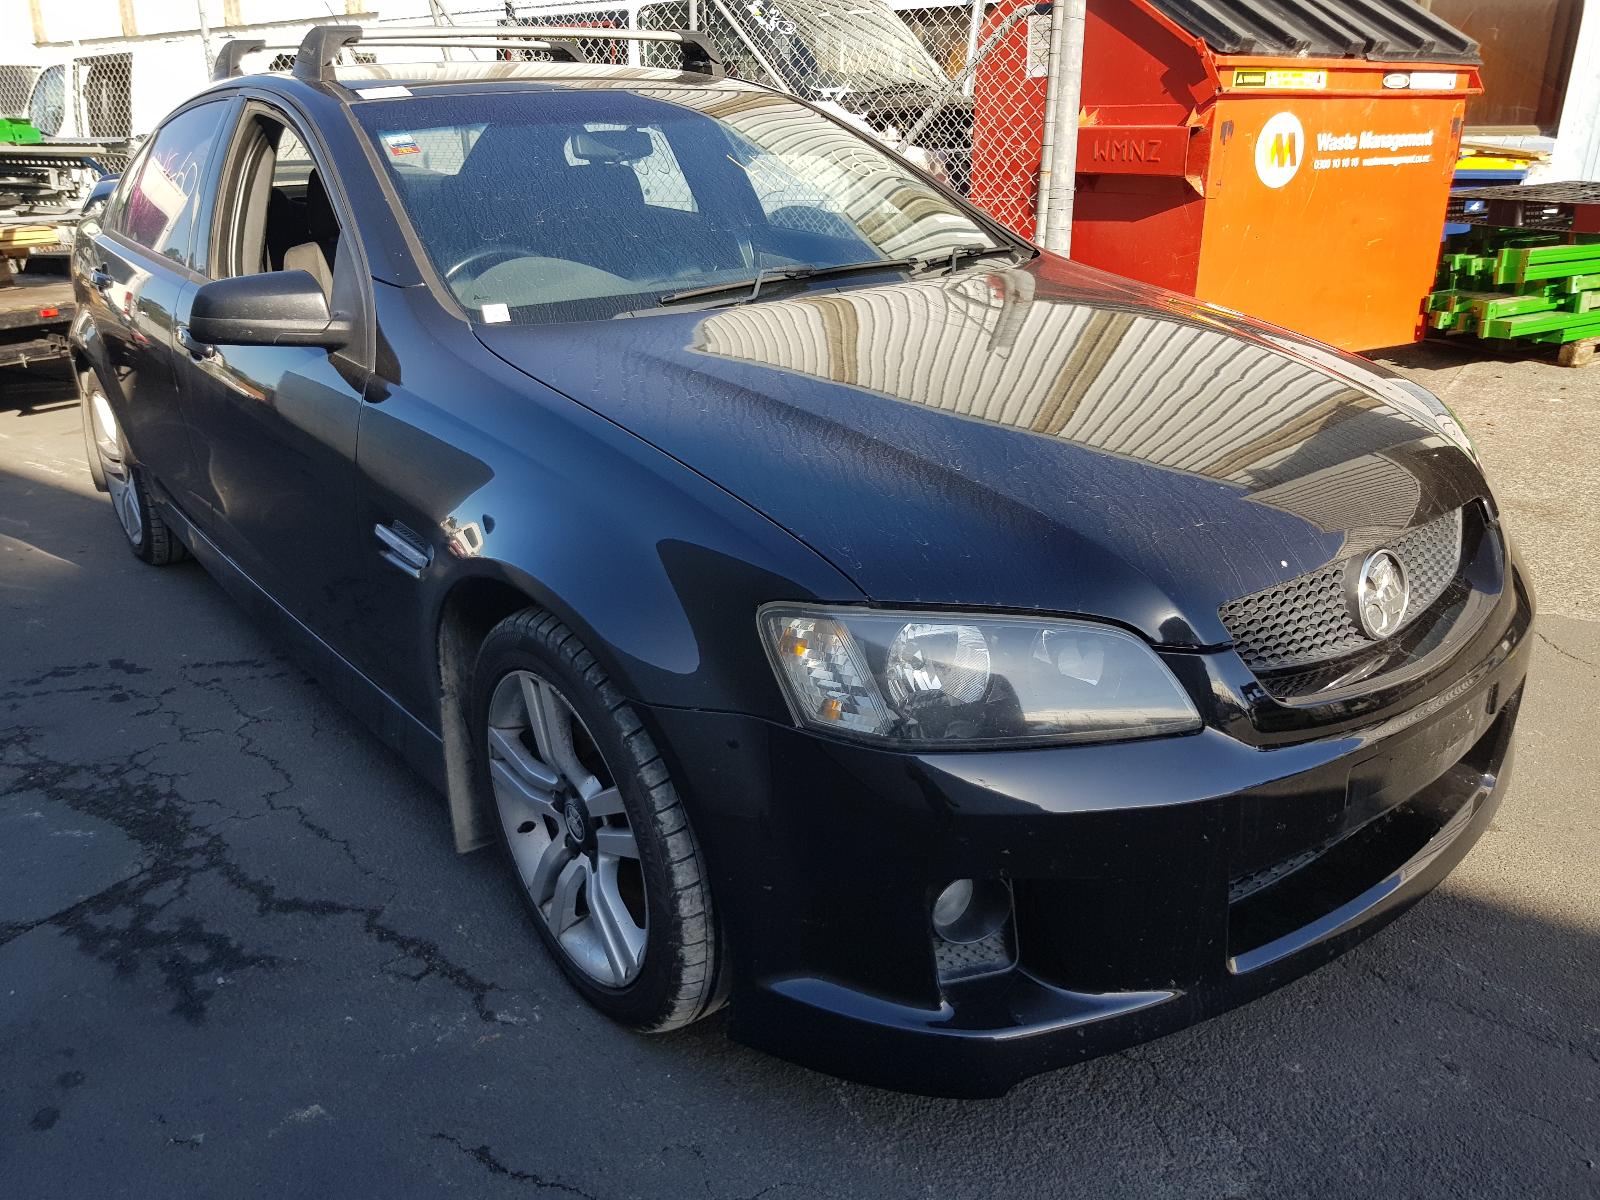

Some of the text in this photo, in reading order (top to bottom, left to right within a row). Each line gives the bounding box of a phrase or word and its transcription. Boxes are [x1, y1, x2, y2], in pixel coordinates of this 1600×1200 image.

[1093, 138, 1162, 162] WMNZ
[1317, 129, 1434, 152] Waste Management
